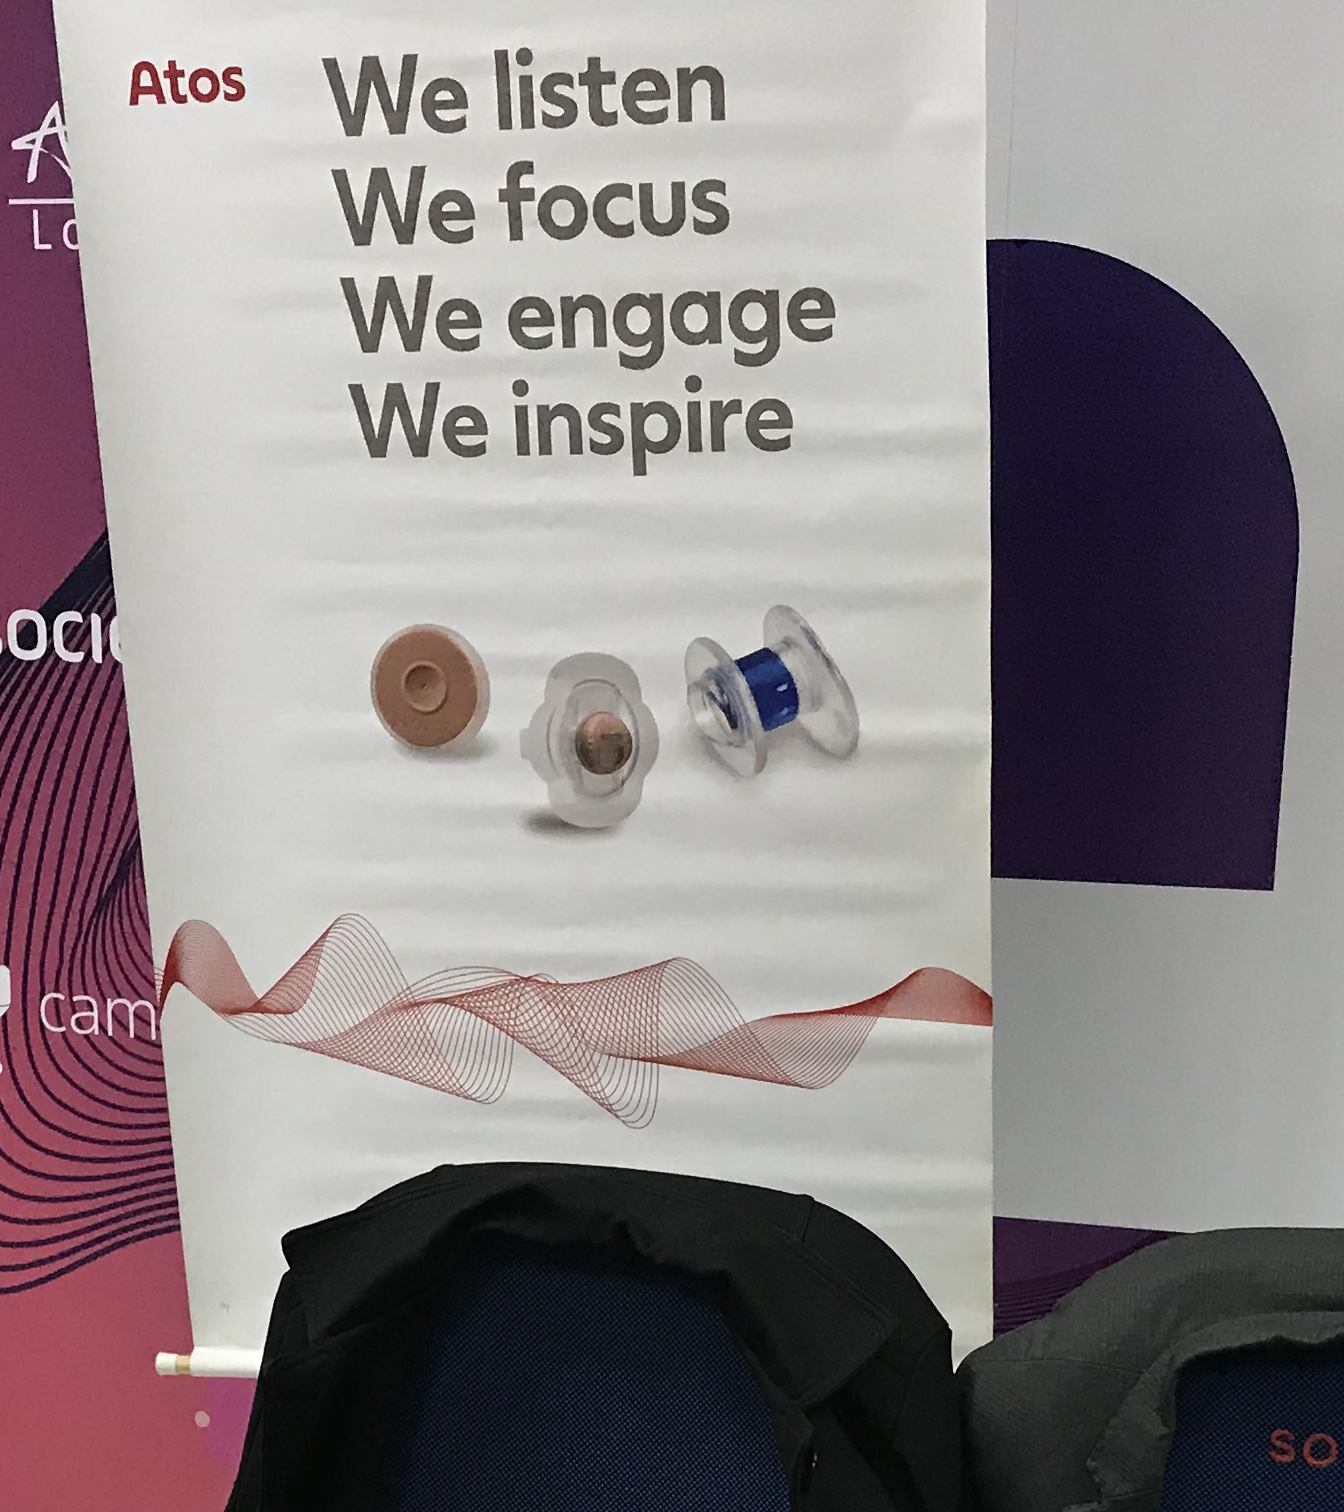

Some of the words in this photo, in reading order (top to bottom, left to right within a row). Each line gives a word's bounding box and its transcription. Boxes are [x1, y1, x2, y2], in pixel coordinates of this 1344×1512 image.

[128, 60, 247, 106] Atos
[322, 53, 469, 136] We
[494, 46, 726, 130] listen
[331, 165, 476, 246] We
[498, 160, 731, 241] focus
[339, 274, 483, 353] We
[507, 286, 837, 371] engage
[347, 381, 489, 458] We
[512, 374, 794, 477] inspire
